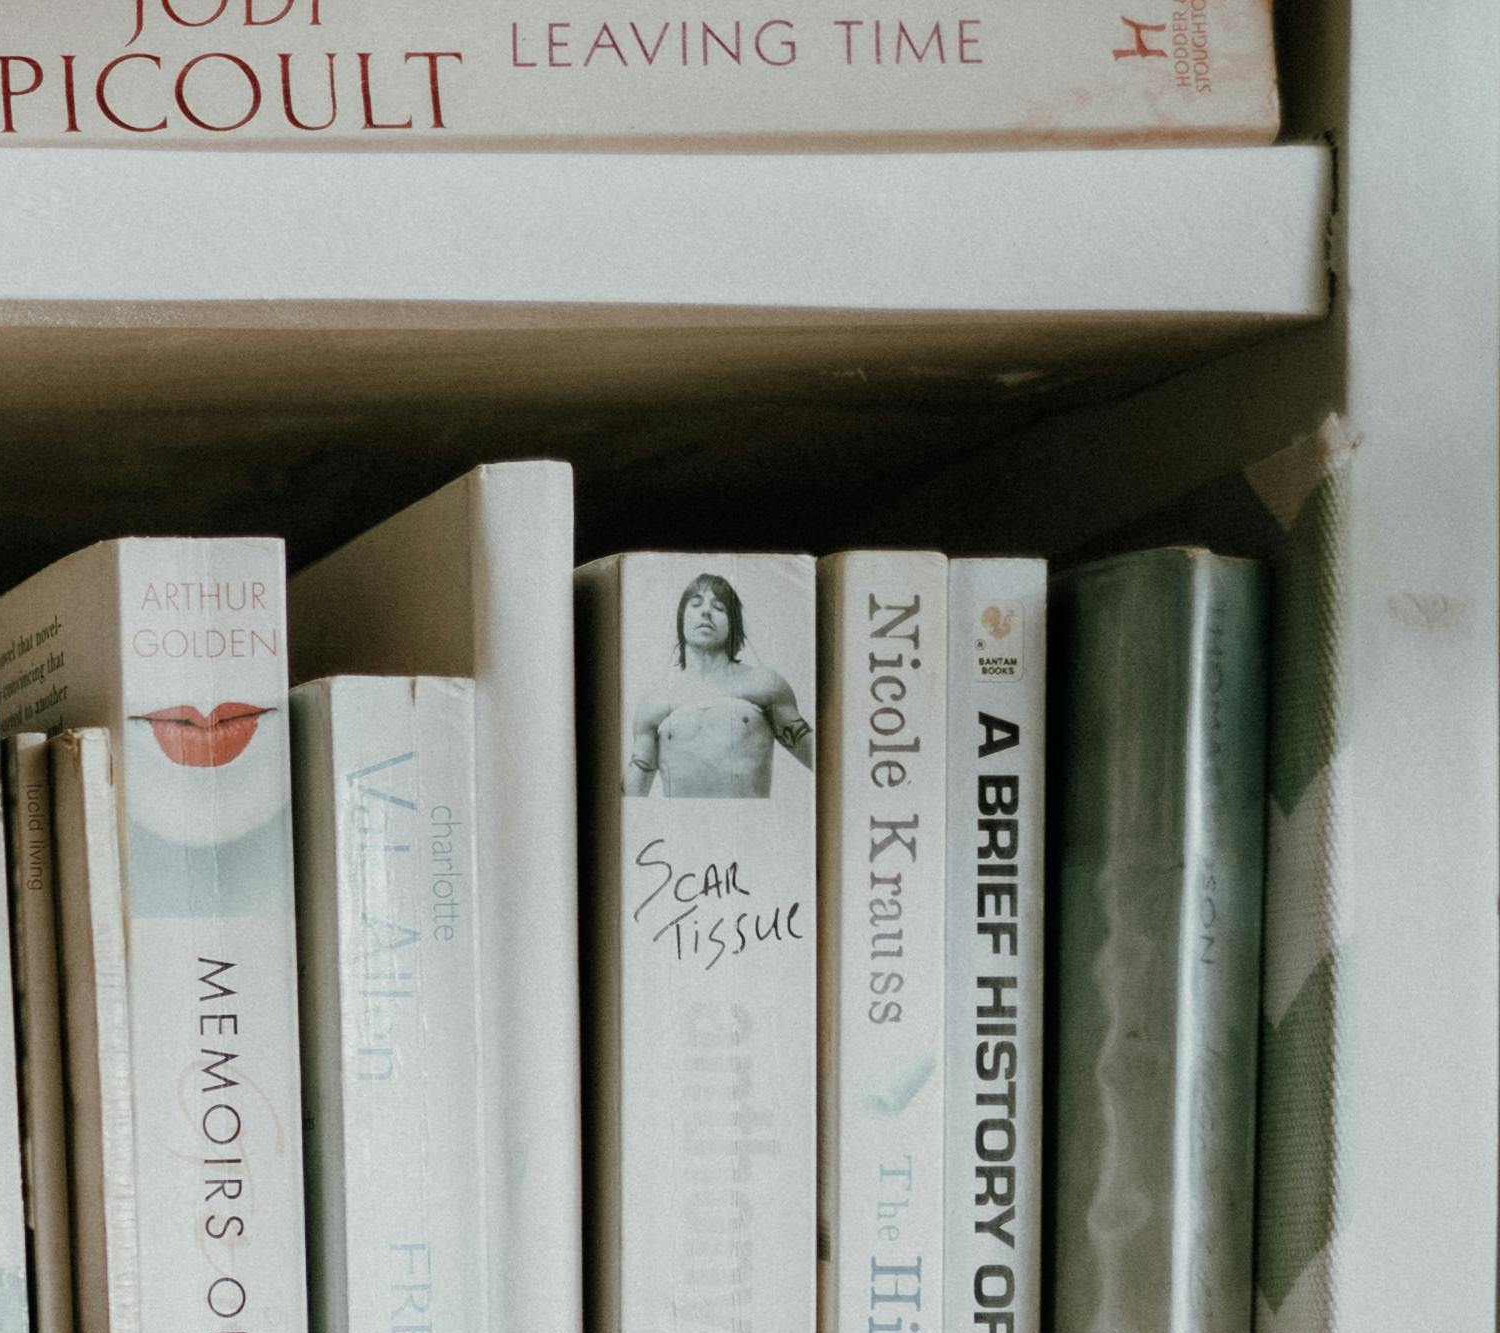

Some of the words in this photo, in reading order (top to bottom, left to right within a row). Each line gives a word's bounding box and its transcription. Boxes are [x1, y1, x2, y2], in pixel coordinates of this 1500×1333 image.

[510, 20, 800, 68] LEAVING
[834, 20, 986, 67] TIME
[976, 711, 1020, 758] A
[975, 775, 1020, 957] BRIEF
[197, 956, 244, 1240] MEMOIRS
[973, 976, 1019, 1250] HISTORY
